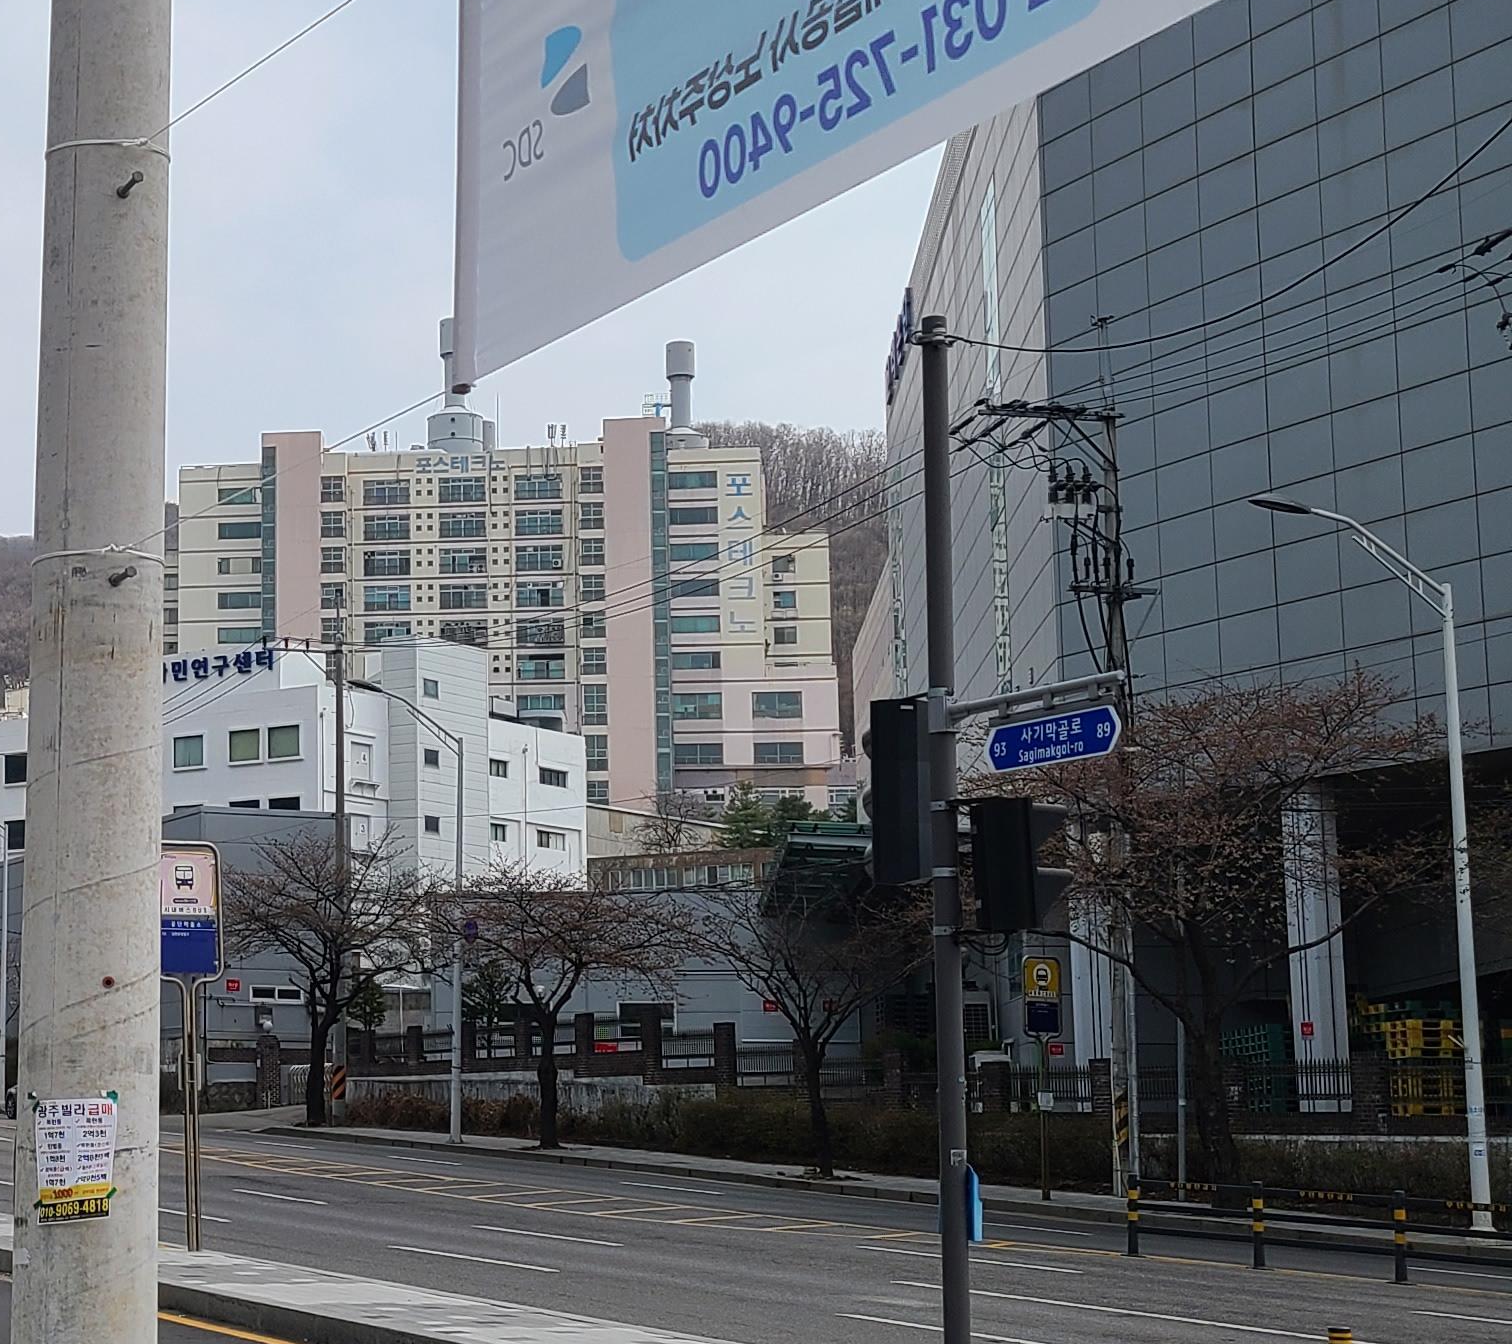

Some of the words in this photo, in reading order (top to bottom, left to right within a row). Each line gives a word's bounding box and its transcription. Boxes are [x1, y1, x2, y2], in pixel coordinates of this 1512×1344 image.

[416, 455, 506, 474] 포스테크노
[725, 473, 757, 634] 포스테크노
[1020, 717, 1083, 744] 사기막골로
[1096, 721, 1111, 739] 89
[994, 741, 1007, 758] 93
[1018, 740, 1084, 764] Sagimakgol-ro
[38, 1104, 59, 1118] 광주
[61, 1103, 85, 1117] 빌라
[87, 1103, 113, 1116] 급매
[40, 1198, 109, 1218] 010-9069-4818
